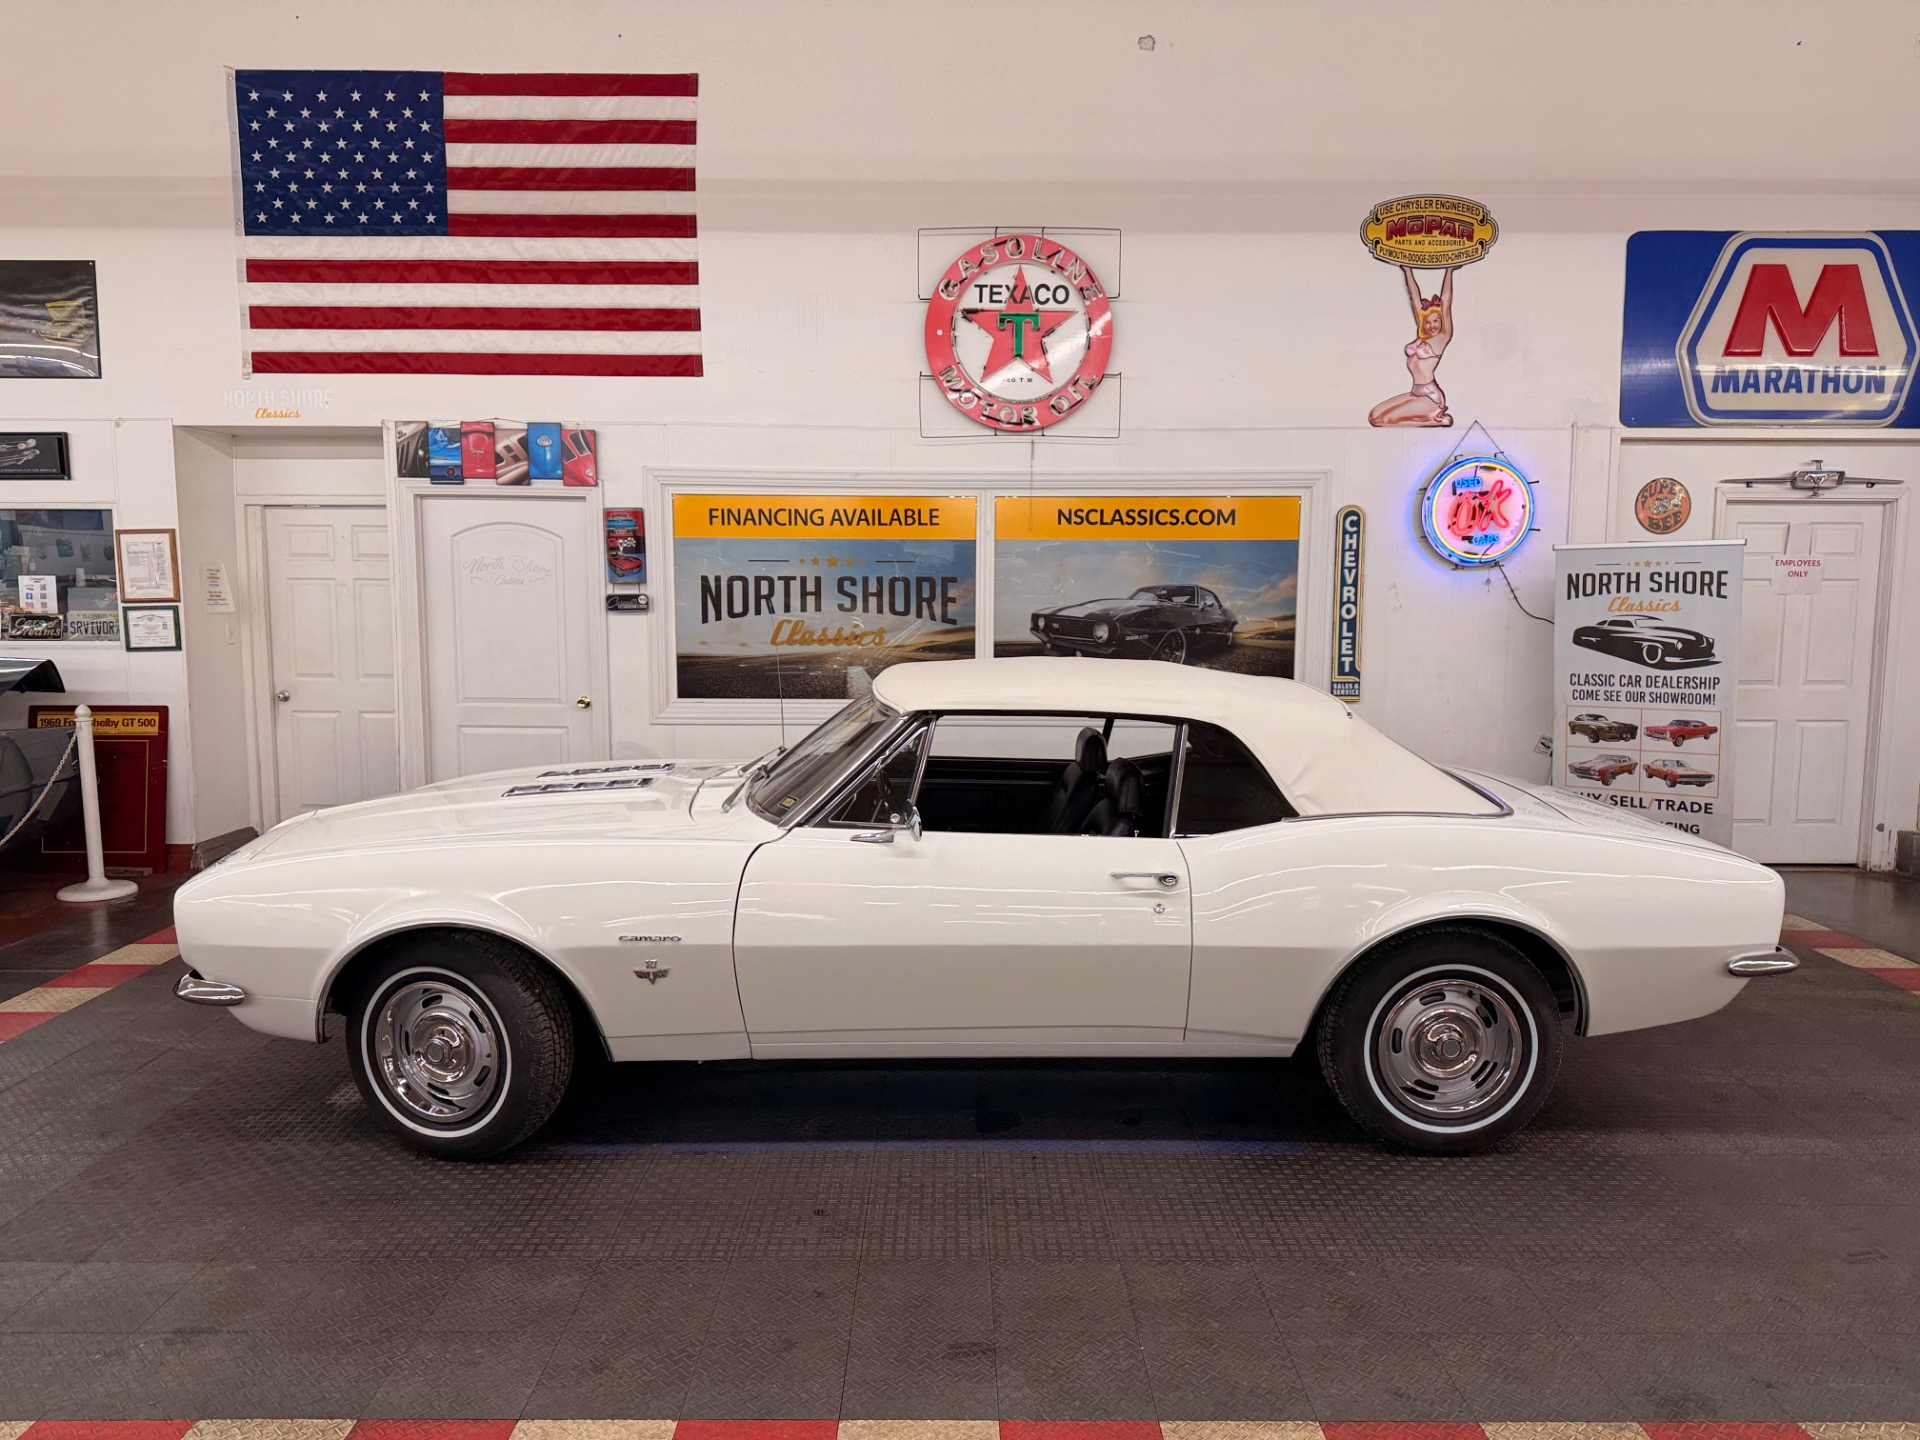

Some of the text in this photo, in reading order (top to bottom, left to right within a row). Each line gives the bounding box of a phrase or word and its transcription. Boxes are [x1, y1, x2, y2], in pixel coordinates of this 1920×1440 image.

[1379, 204, 1395, 215] USE
[1395, 199, 1434, 211] CHRYSLER
[1435, 199, 1481, 217] ENGINEERED
[1386, 214, 1475, 242] MOPAR
[1427, 239, 1466, 247] ACCESSORIES
[938, 236, 1104, 306] GASOLINE
[973, 283, 1070, 306] TEXACO
[1721, 263, 1880, 357] M
[997, 311, 1041, 359] T
[1710, 365, 1887, 394] MARATHON
[223, 388, 333, 411] NORTH SHORE
[938, 365, 1100, 428] MOTOR OIL
[254, 407, 302, 419] Classics
[1454, 477, 1483, 488] USED
[708, 508, 940, 527] FINANCING AVAILABLE
[1056, 508, 1237, 527] NSCLASSICS.COM
[1448, 479, 1513, 538] OK
[1647, 510, 1682, 531] BEE
[1472, 534, 1500, 545] CARS
[1775, 559, 1821, 567] EMPLOYEES
[1787, 570, 1809, 578] ONLY
[1342, 515, 1359, 674] CHEVROLET
[1567, 570, 1729, 601] NORTH SHORE
[700, 574, 958, 626] NORTH SHORE
[1607, 596, 1683, 613] Classics
[769, 618, 888, 648] Classics
[1569, 673, 1721, 690] CLASSIC CAR DEALERSHIP
[1572, 689, 1716, 706] COME SEE OUR SHOWROOM!
[40, 717, 61, 727] 1969
[92, 717, 120, 729] helby
[122, 718, 135, 727] GT
[137, 718, 157, 727] 500
